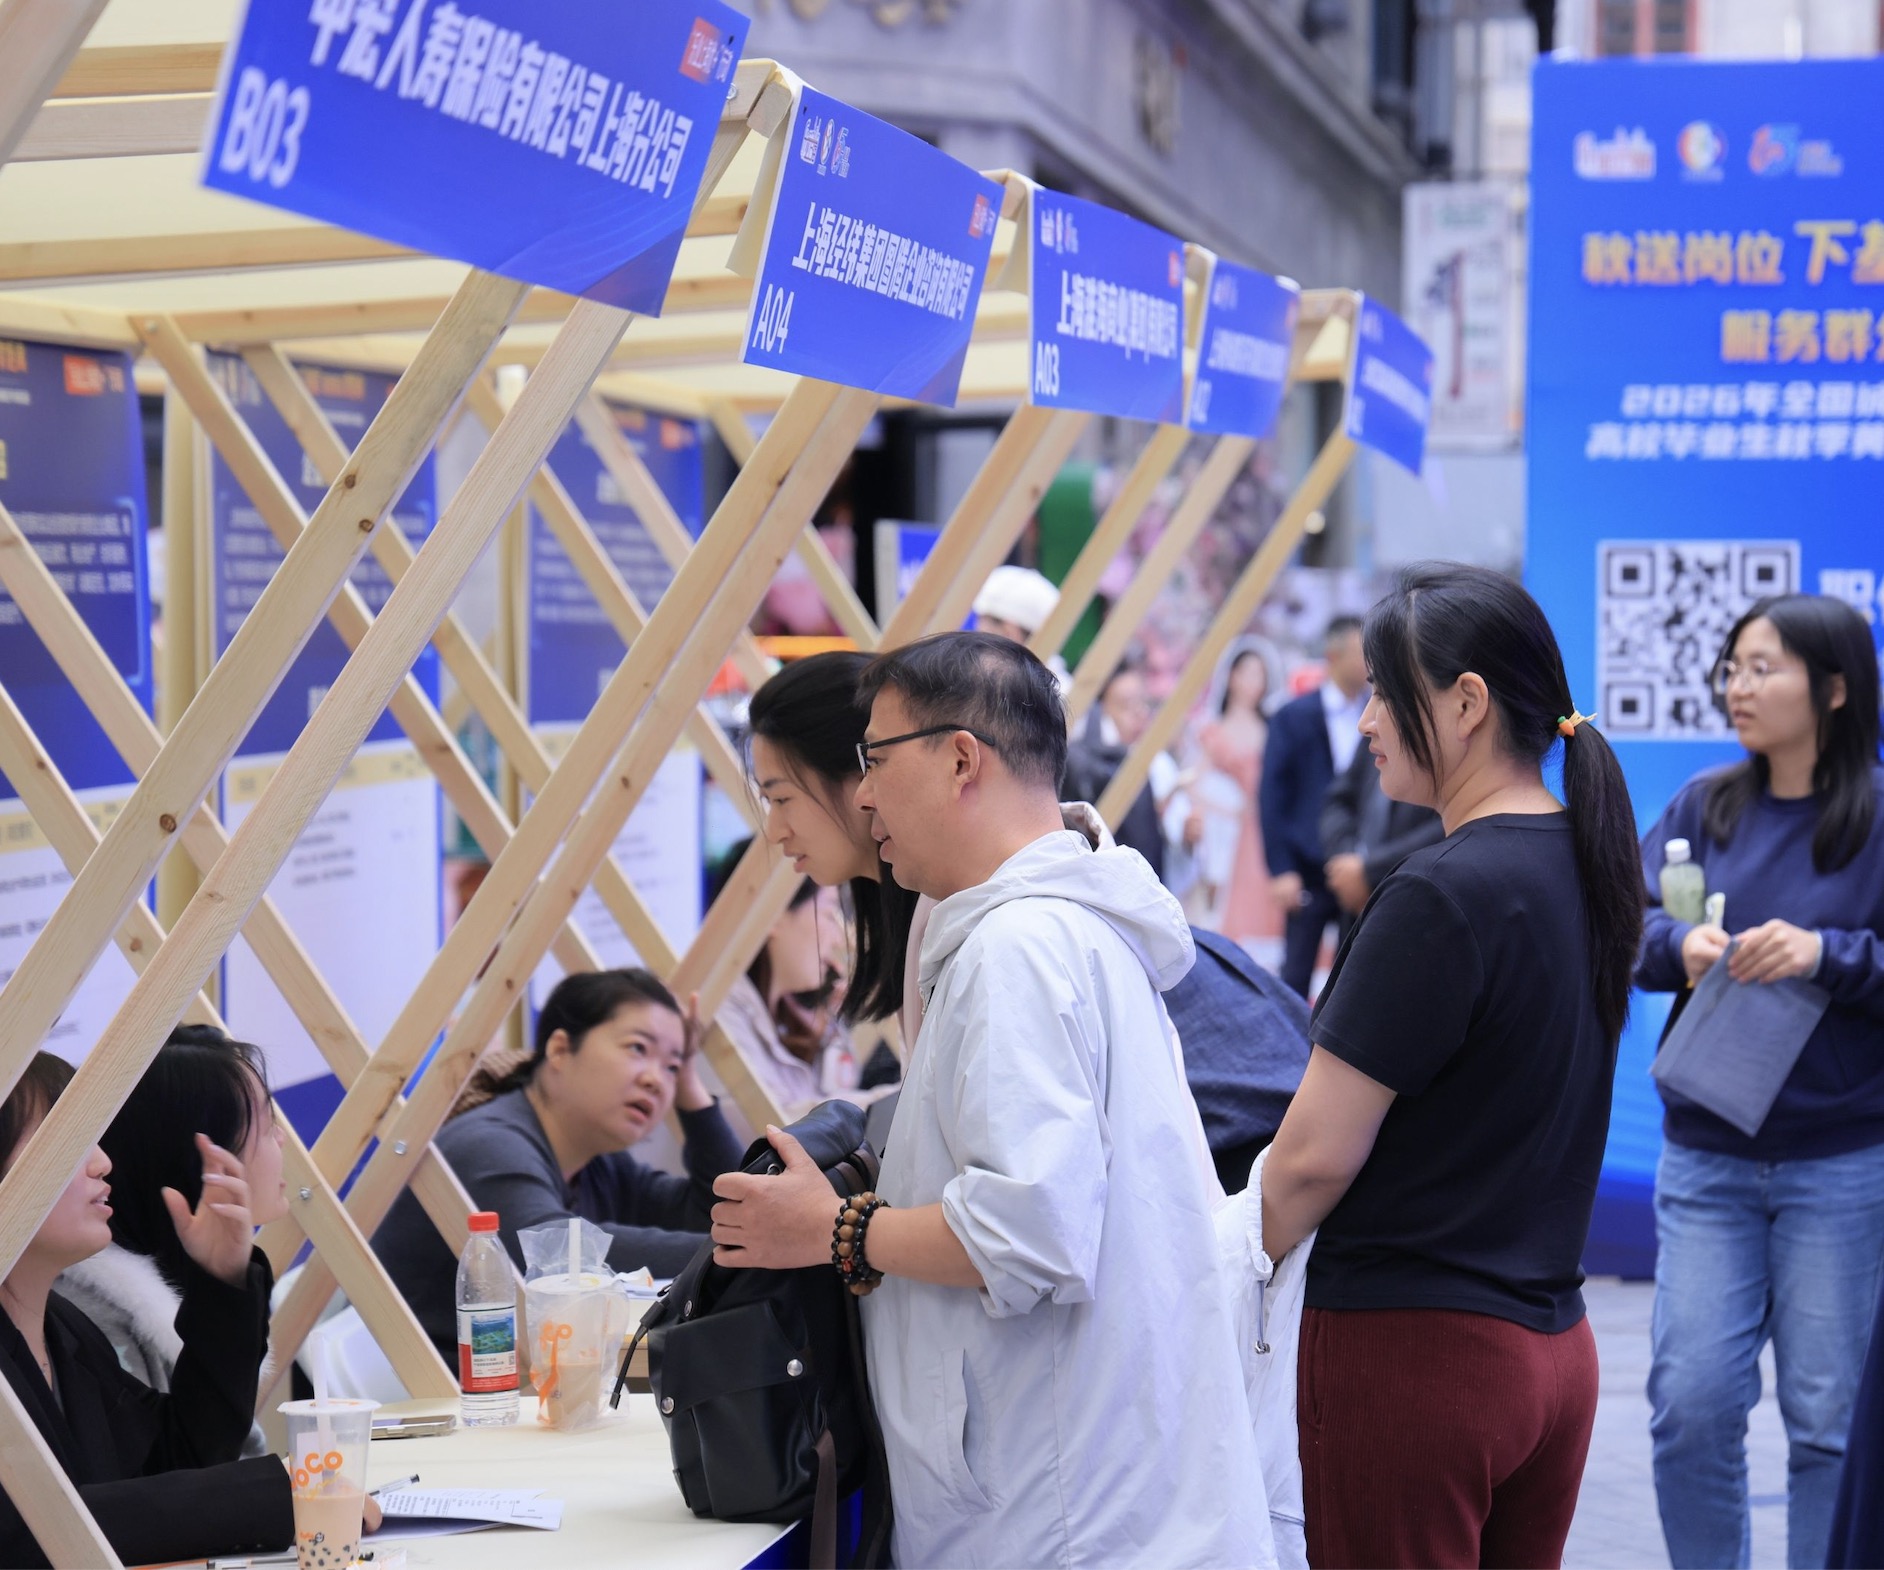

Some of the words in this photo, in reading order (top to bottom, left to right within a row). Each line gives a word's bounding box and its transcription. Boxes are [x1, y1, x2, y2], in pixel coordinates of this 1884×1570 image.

[218, 67, 310, 188] B03
[752, 283, 794, 354] A04
[1720, 308, 1884, 364] 服务群
[1034, 340, 1060, 397] A03
